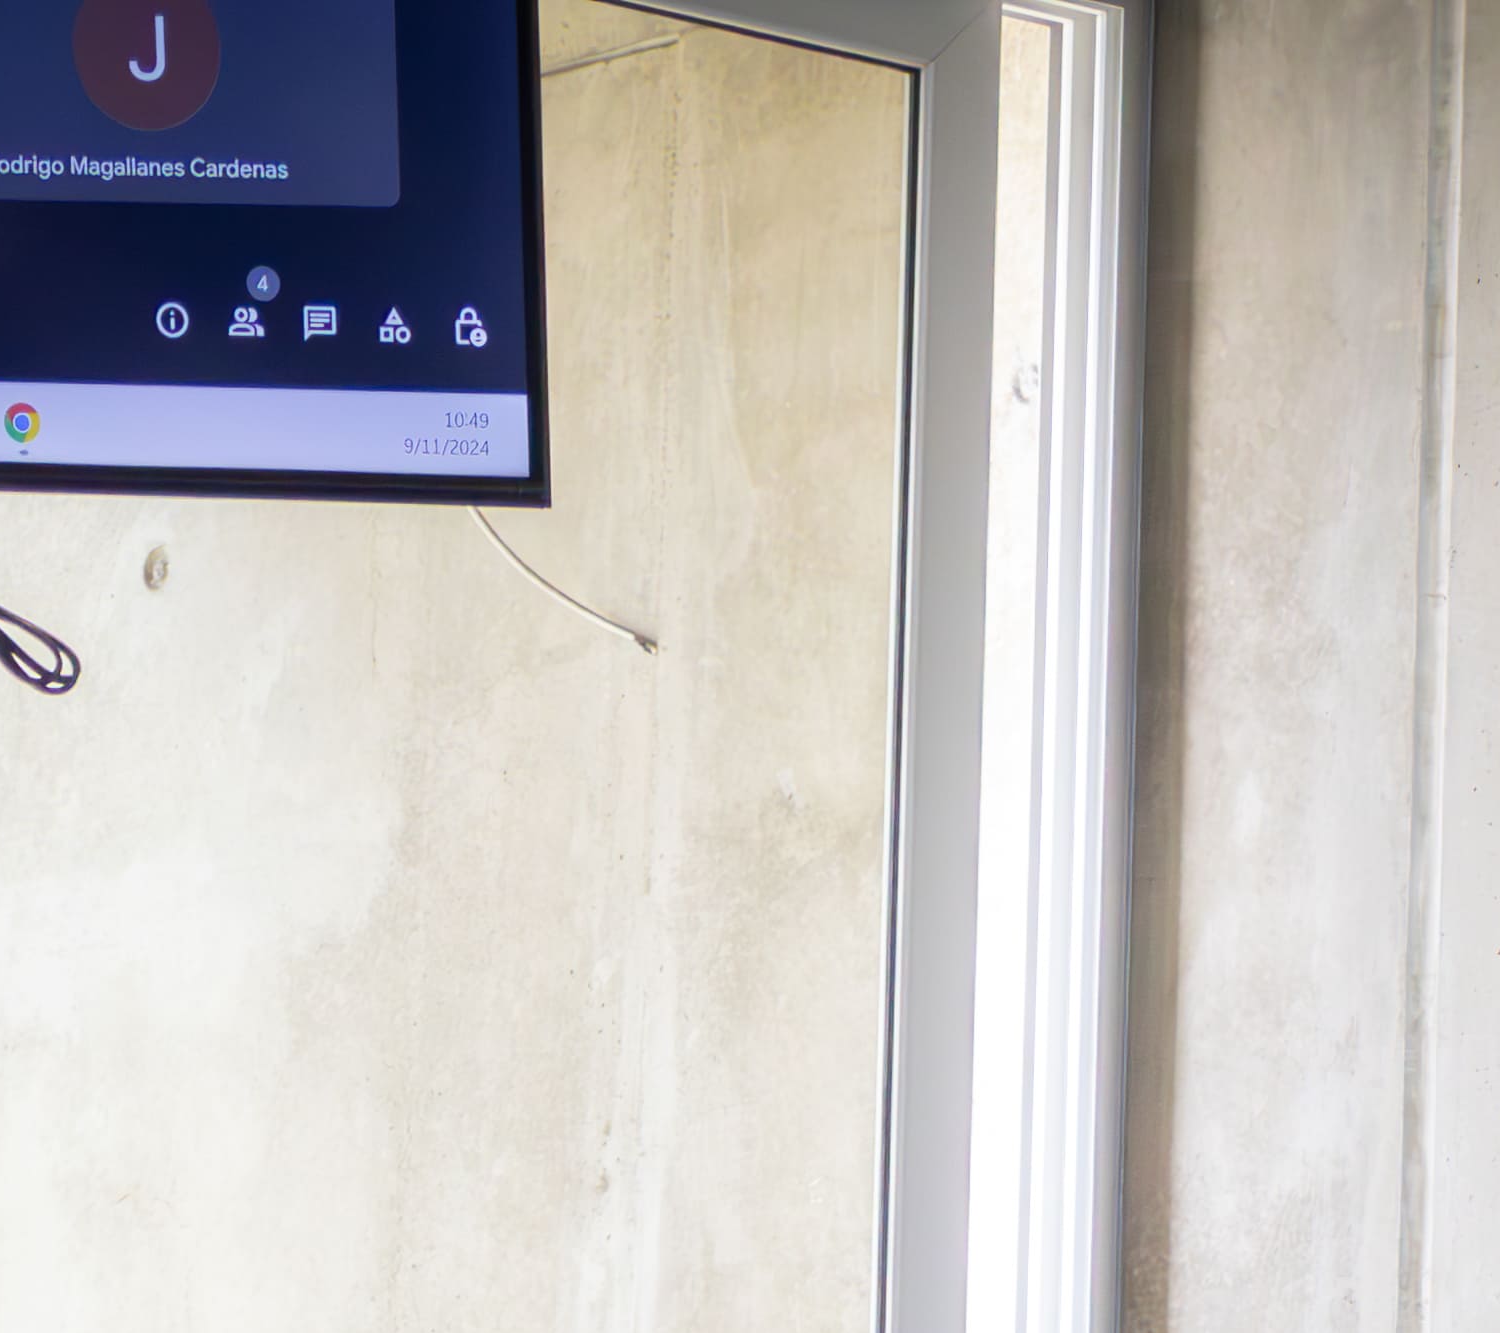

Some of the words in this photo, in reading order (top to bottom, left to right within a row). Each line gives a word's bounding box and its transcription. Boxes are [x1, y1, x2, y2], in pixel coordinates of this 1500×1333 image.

[128, 15, 166, 82] J
[69, 155, 186, 181] Magallanes
[190, 157, 290, 180] Cardenas
[256, 274, 269, 292] 4
[444, 411, 490, 429] 10:49
[403, 438, 490, 456] 9/11/2024
